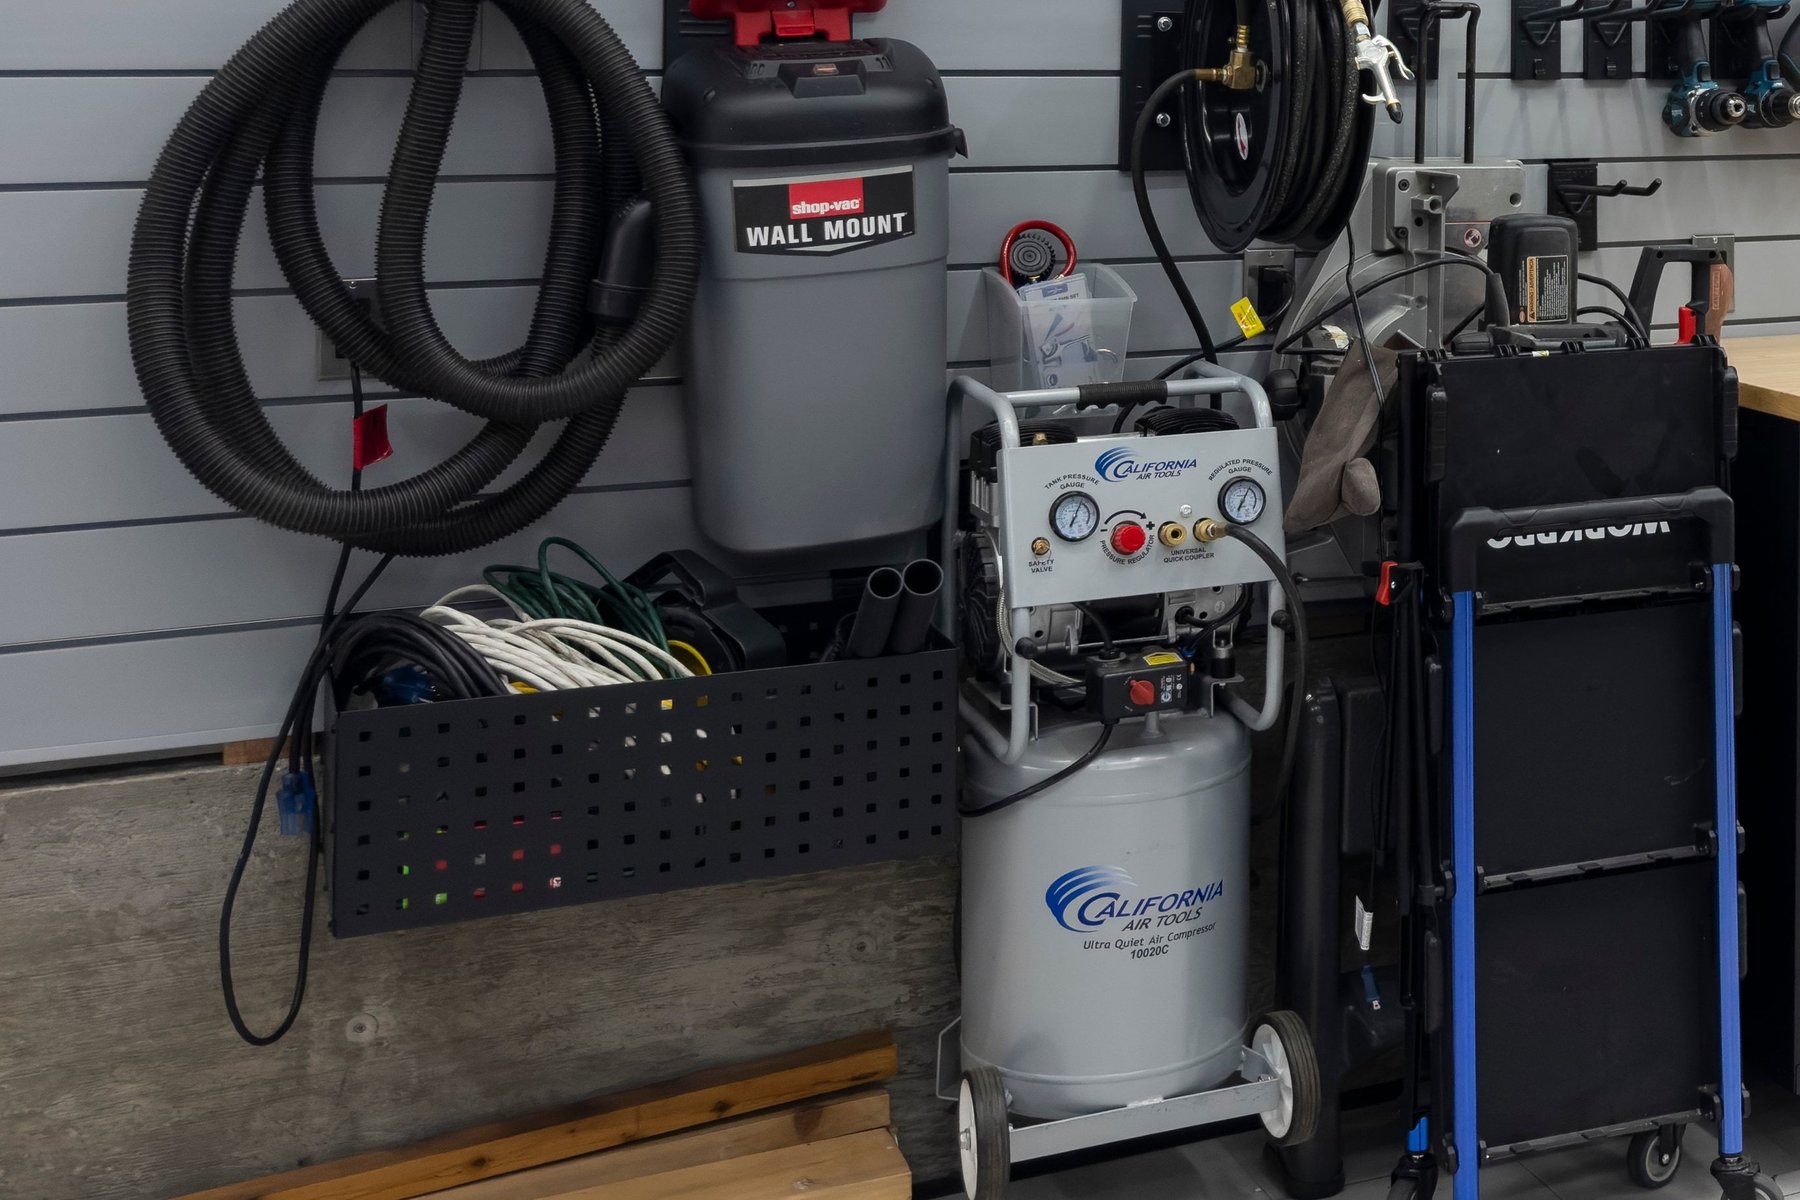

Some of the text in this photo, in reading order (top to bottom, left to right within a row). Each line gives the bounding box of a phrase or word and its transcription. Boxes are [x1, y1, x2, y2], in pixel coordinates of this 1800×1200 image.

[746, 212, 908, 247] WALL MOUNT
[1113, 459, 1197, 478] CALIFORNIA
[1154, 469, 1181, 479] TOOLS
[1208, 458, 1273, 481] REGULATED PRESSURE
[1228, 466, 1252, 474] GAUGE
[1044, 473, 1100, 490] TANK PRESSURE
[1060, 481, 1085, 490] GAUGE
[1100, 534, 1155, 565] PRESSURE REGULATOR
[1170, 546, 1206, 556] UNIVERSAL
[1185, 552, 1215, 561] COUPLER
[1028, 558, 1055, 567] SAFETY
[1077, 879, 1224, 926] CALIFORNIA
[1122, 907, 1203, 932] AIR TOOLS
[1083, 921, 1217, 950] Ultra Quiet Air Compressor
[1130, 944, 1170, 959] 10020C
